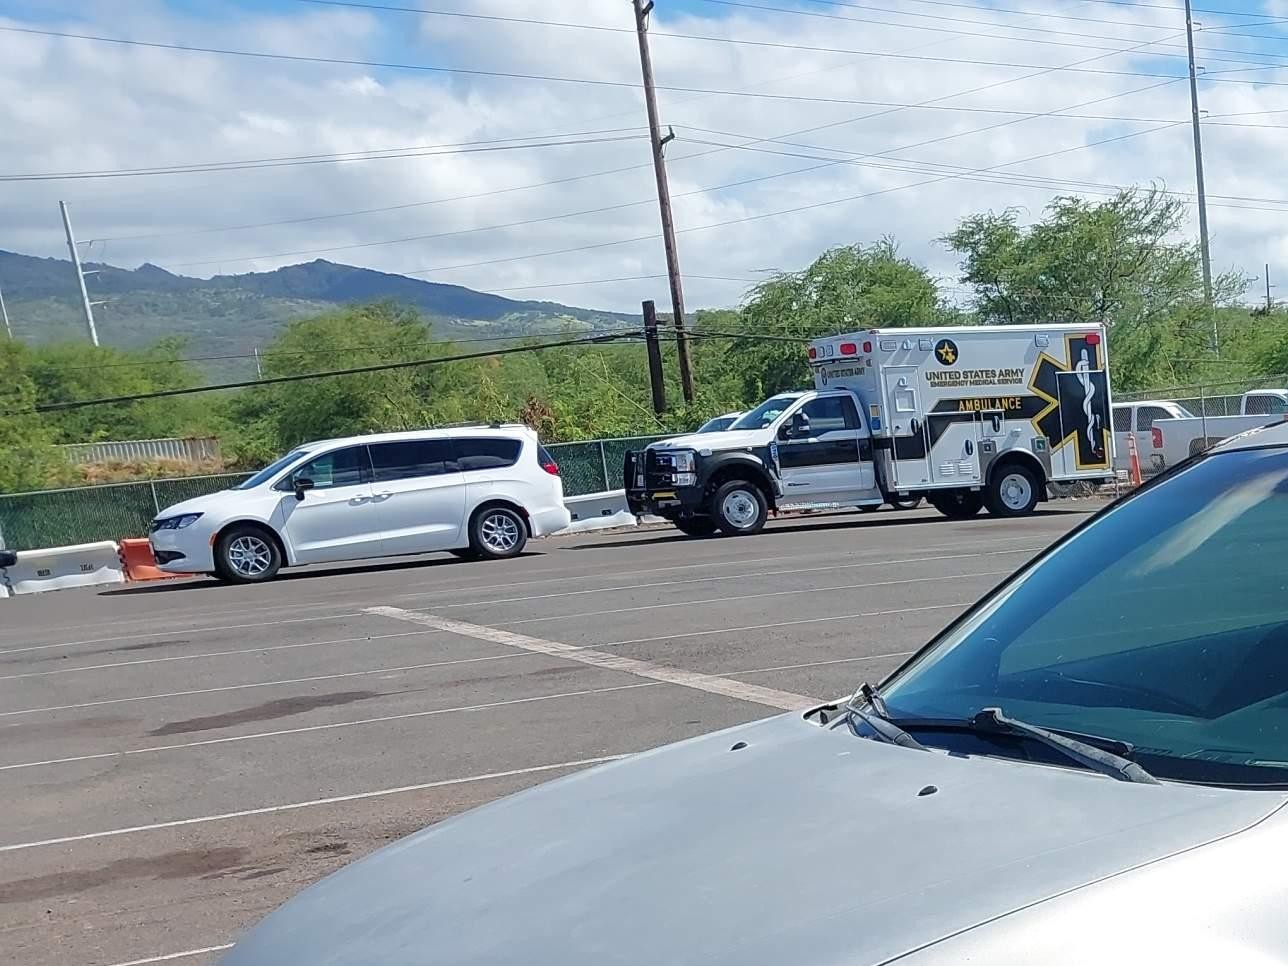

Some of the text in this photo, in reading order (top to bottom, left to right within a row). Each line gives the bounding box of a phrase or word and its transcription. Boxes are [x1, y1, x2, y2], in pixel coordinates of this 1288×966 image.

[925, 368, 1025, 381] UNITED STATES ARMY
[930, 377, 1023, 388] EMERGENCY MEDICAL SERVICE
[958, 397, 1022, 411] AMBULANCE
